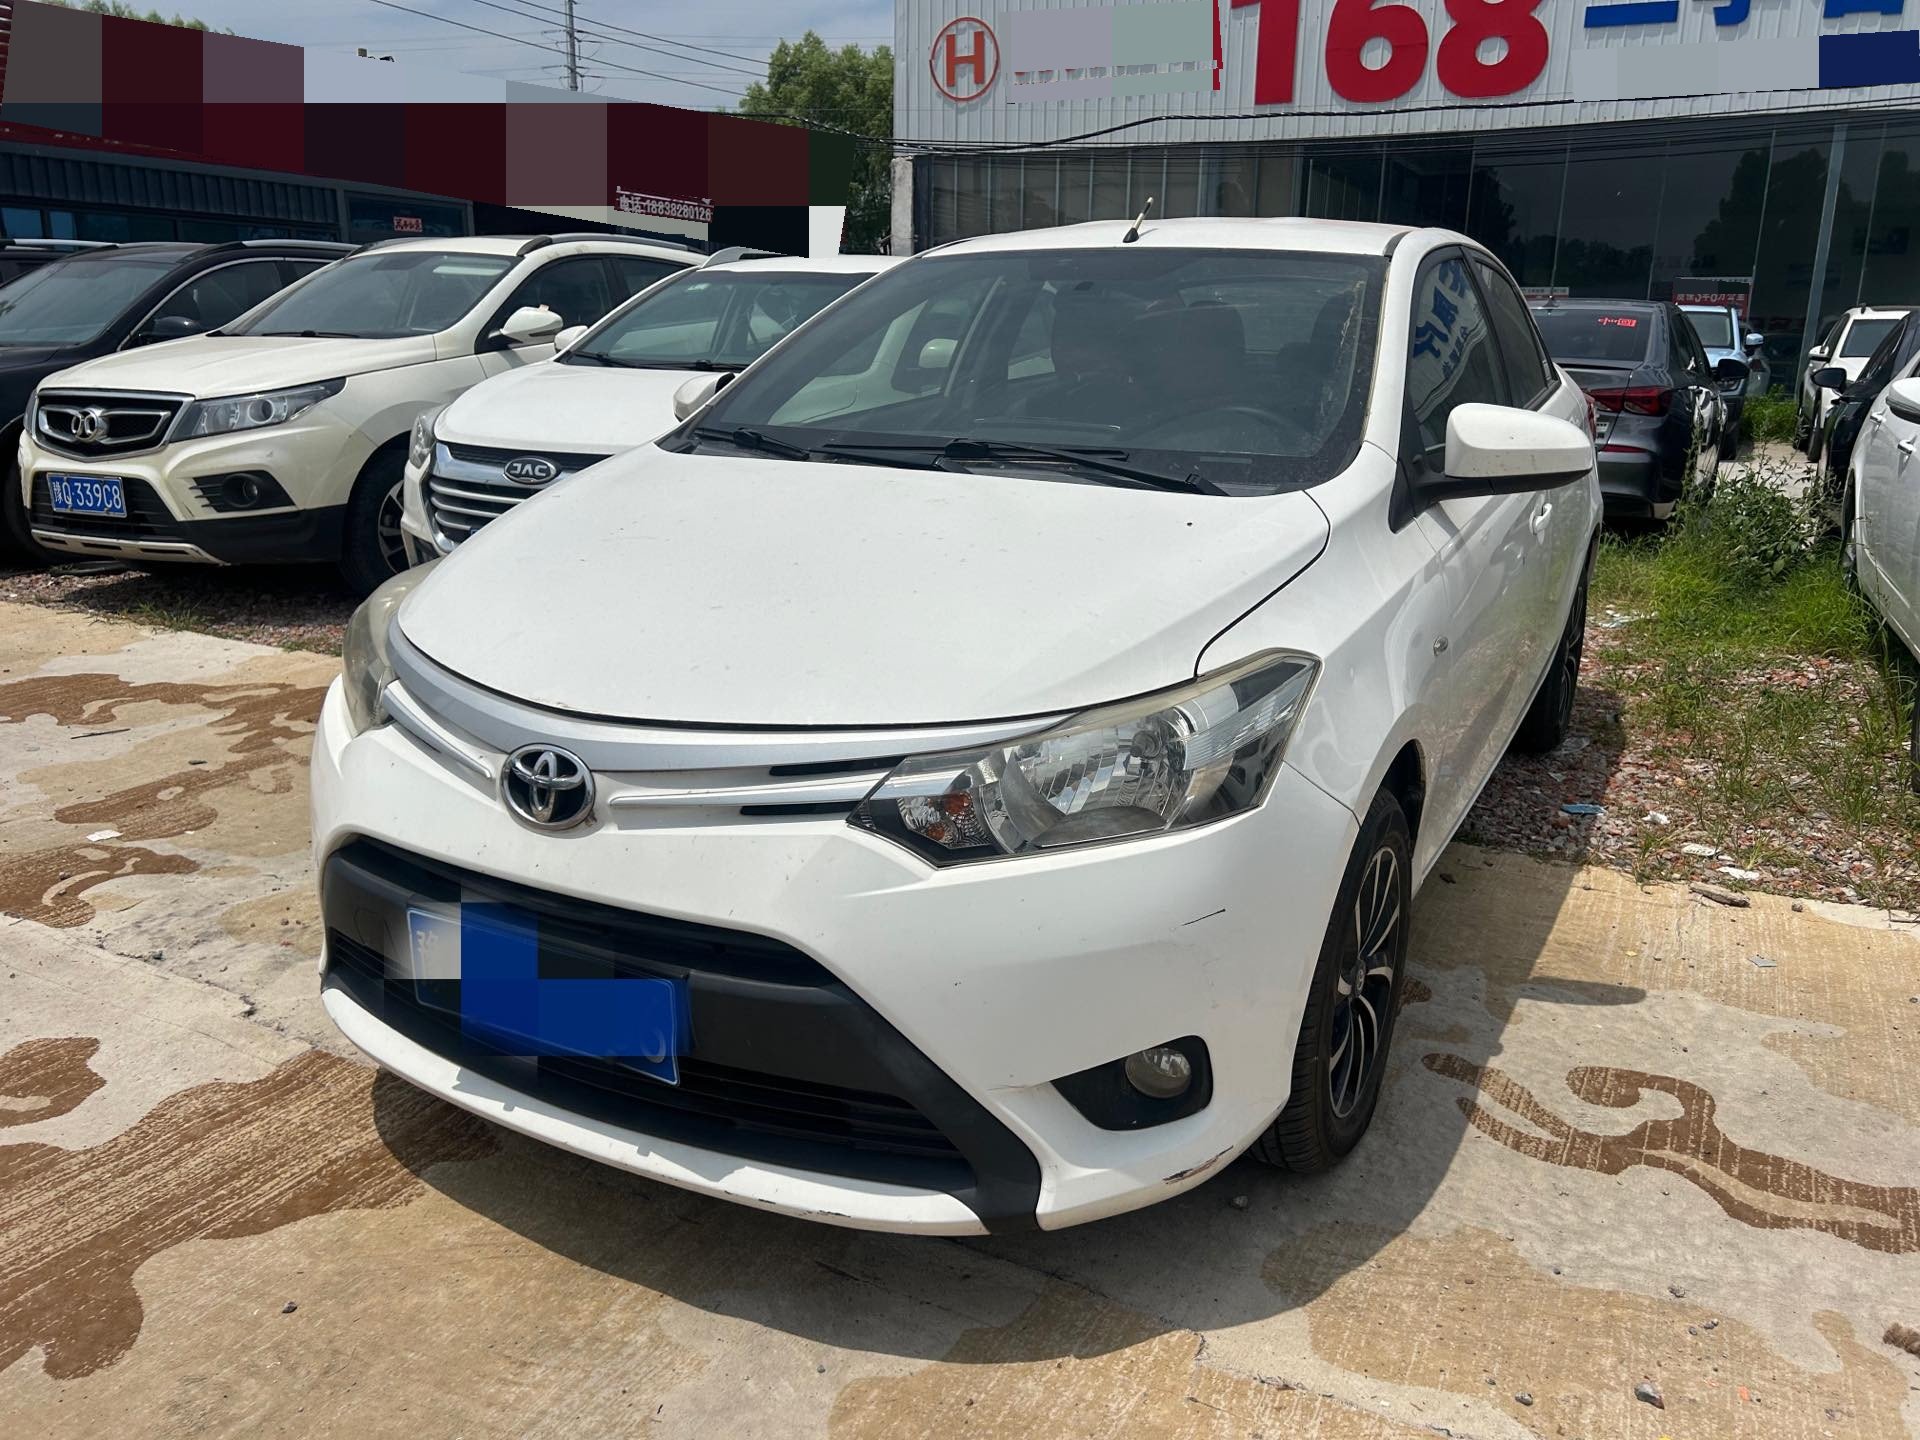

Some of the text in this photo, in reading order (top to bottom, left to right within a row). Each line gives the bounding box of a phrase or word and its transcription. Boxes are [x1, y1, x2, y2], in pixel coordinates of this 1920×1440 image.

[945, 30, 986, 88] H
[1230, 0, 1549, 105] 168
[510, 463, 548, 477] JAC
